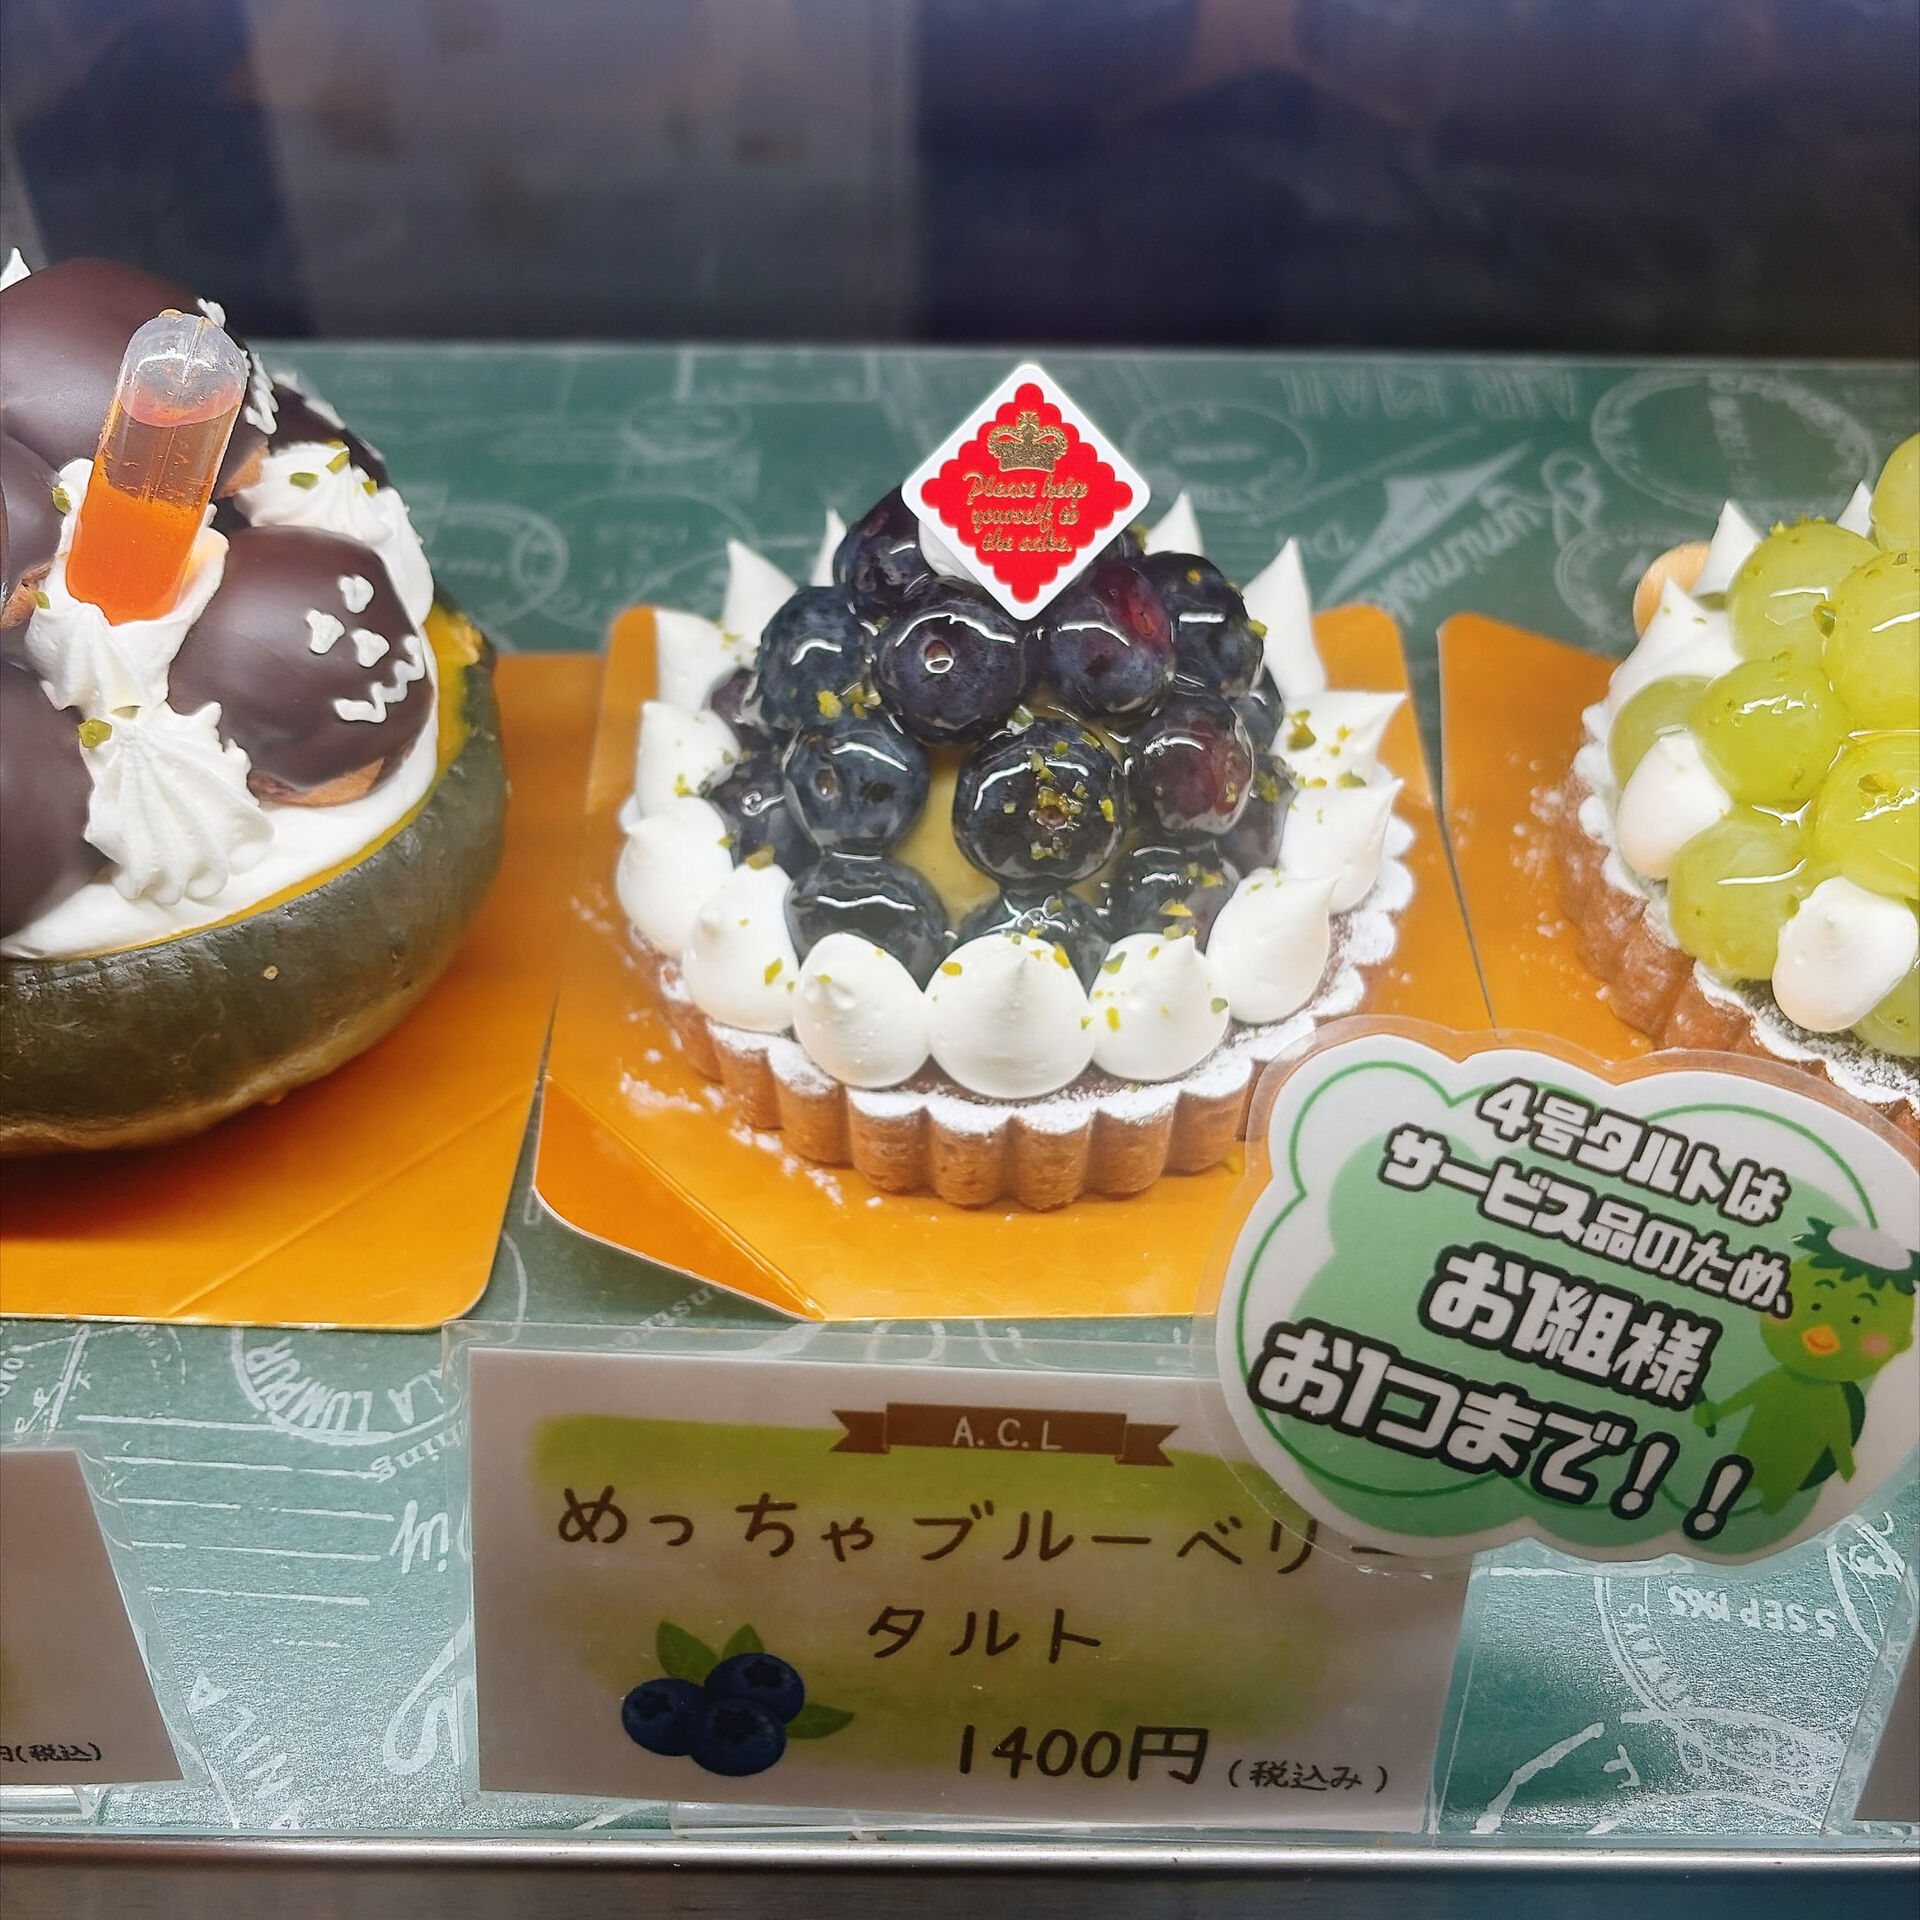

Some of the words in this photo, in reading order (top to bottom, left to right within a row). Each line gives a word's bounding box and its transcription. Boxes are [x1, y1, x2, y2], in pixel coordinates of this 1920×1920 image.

[962, 471, 1037, 506] Please
[1041, 472, 1089, 508] help
[971, 499, 1054, 534] yourself
[982, 526, 1013, 552] the
[1479, 1079, 1790, 1223] 4号タルトは
[1381, 1126, 1792, 1316] サービス品のため、
[1421, 1244, 1721, 1408] お1組様
[558, 1484, 1406, 1575] めっちゃブルーベリー
[867, 1605, 1102, 1664] タルト
[958, 1723, 1210, 1784] 1400円
